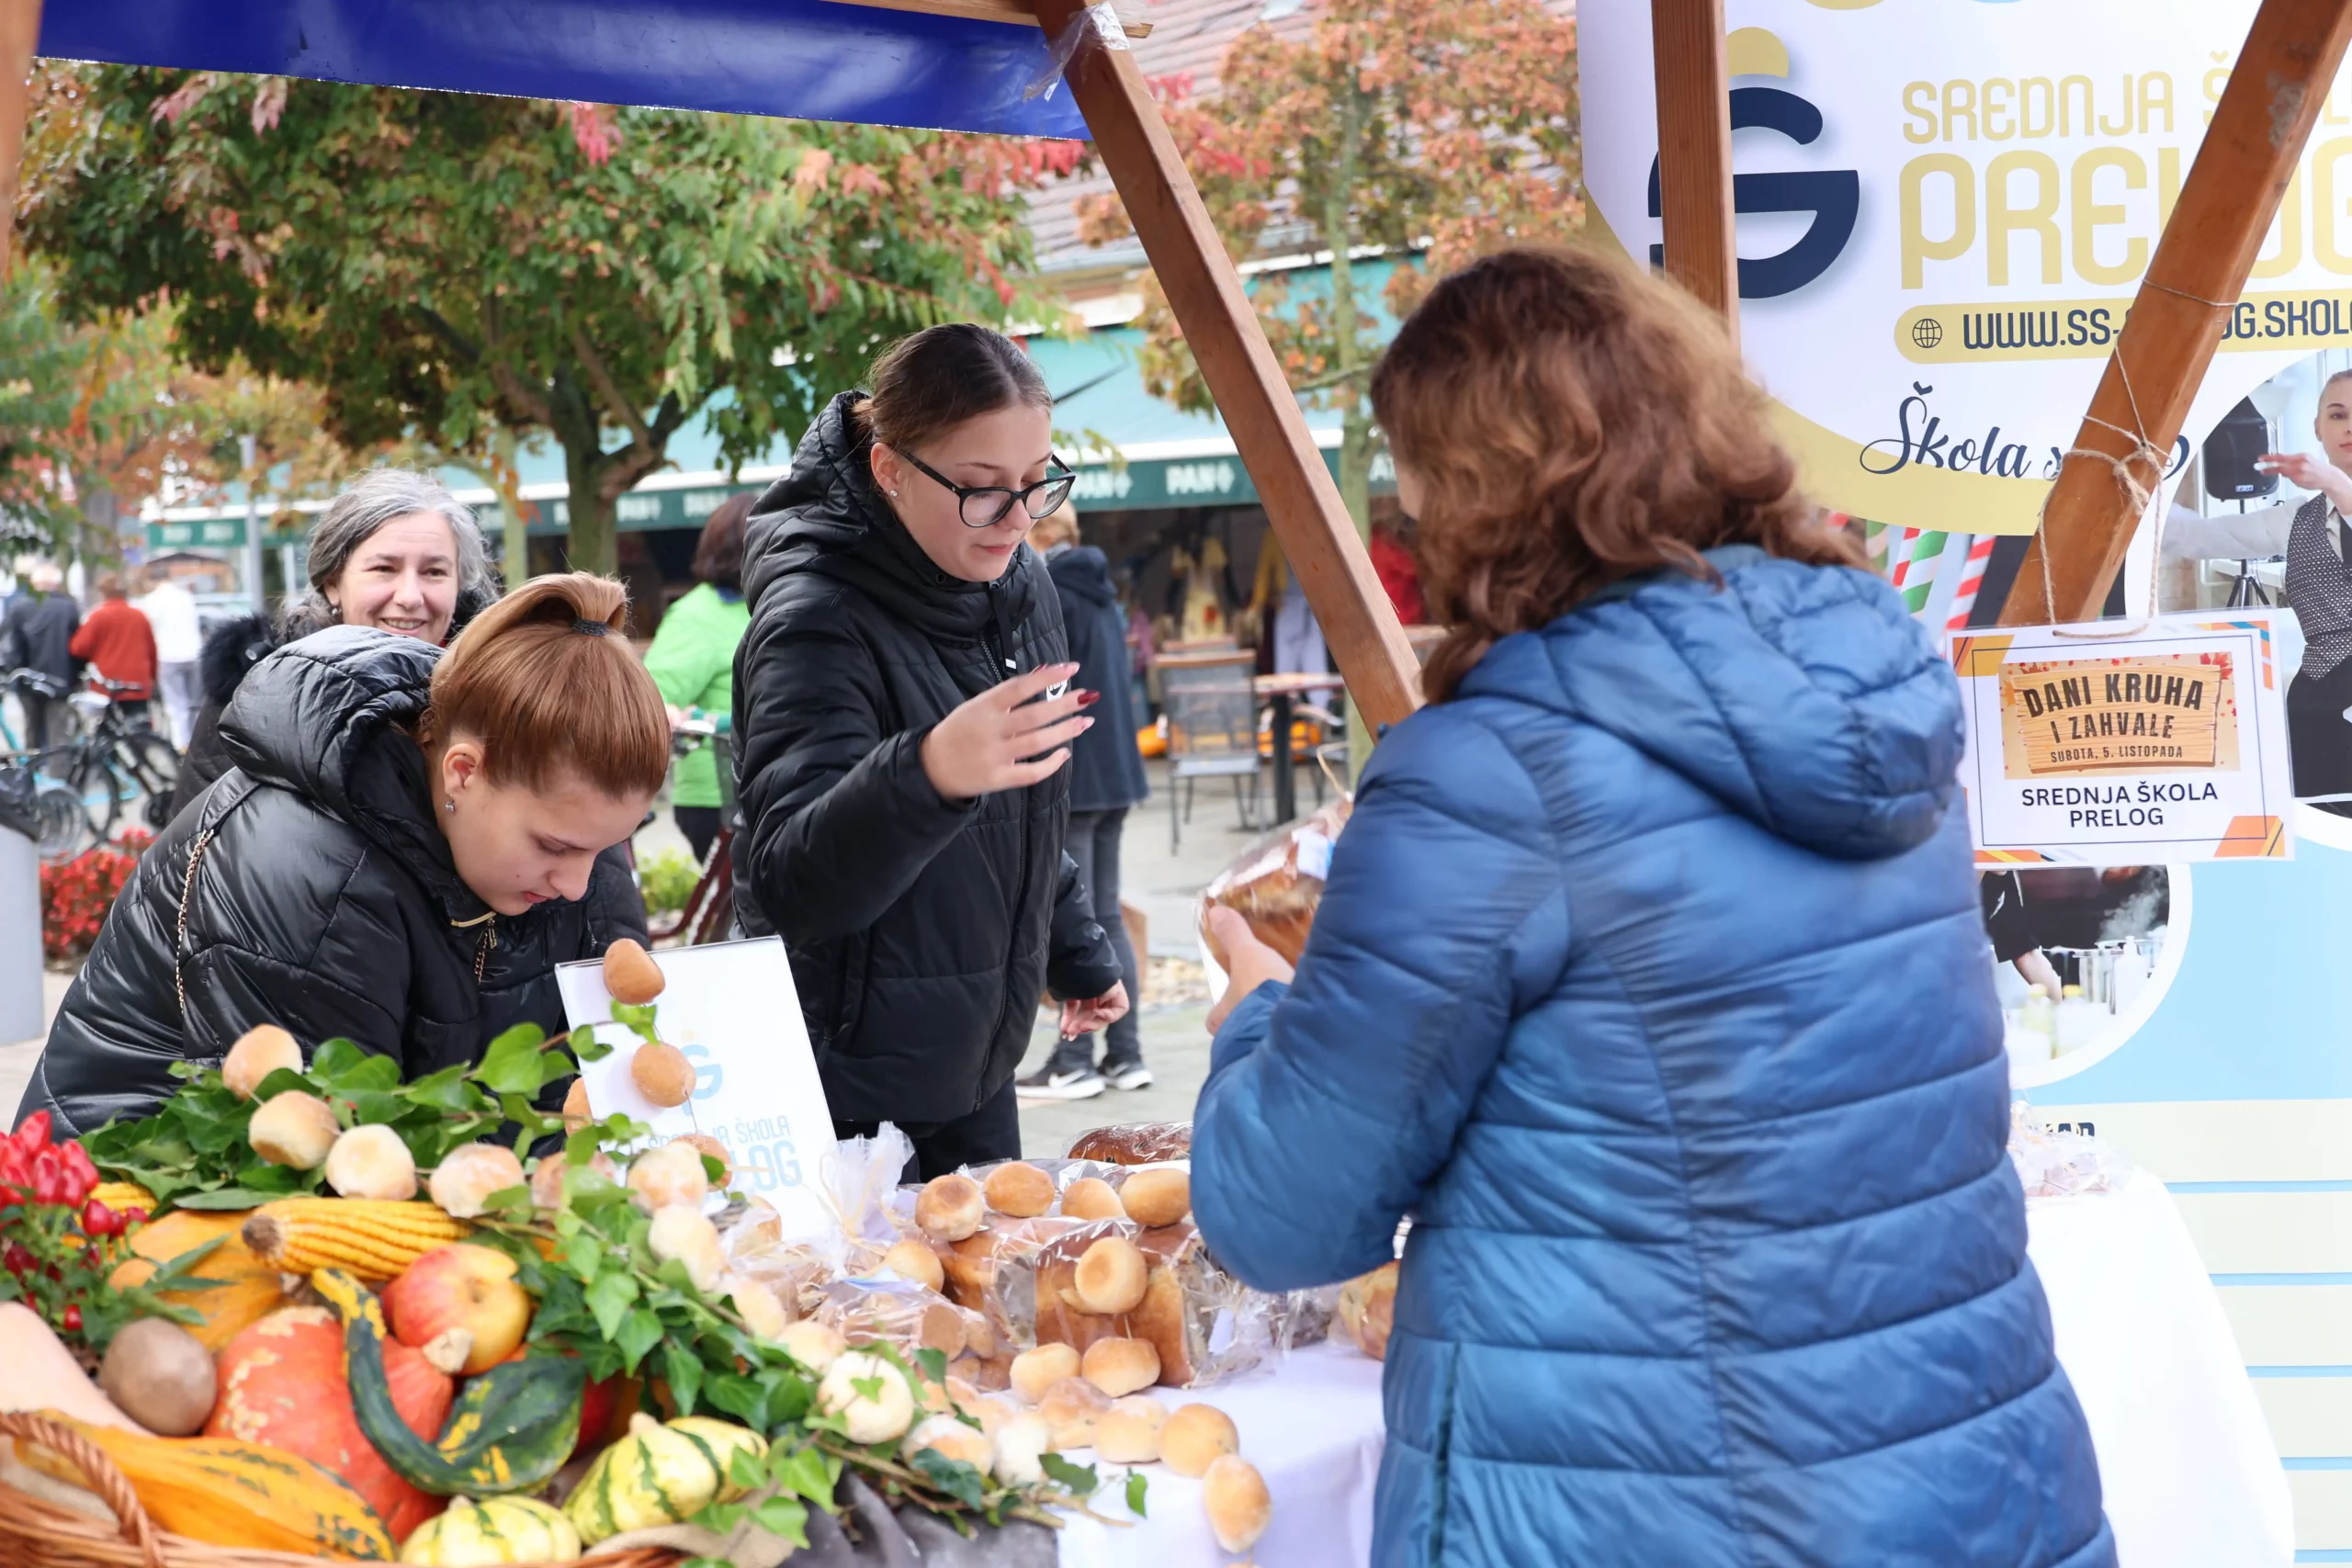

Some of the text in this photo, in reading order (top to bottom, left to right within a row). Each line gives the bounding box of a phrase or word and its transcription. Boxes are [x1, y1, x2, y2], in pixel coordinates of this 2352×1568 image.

[1902, 71, 2175, 145] SREDNJA
[1860, 380, 2031, 479] Škola
[2023, 672, 2203, 718] DANI KRUHA
[2050, 712, 2175, 744] I ZAHVALE
[2103, 749, 2114, 759] 5.
[2119, 745, 2183, 759] LISTOPADA
[2021, 781, 2219, 807] SREDNJA ŠKOLA
[2069, 807, 2164, 828] PRELOG
[735, 1115, 791, 1145] ŠKOLA
